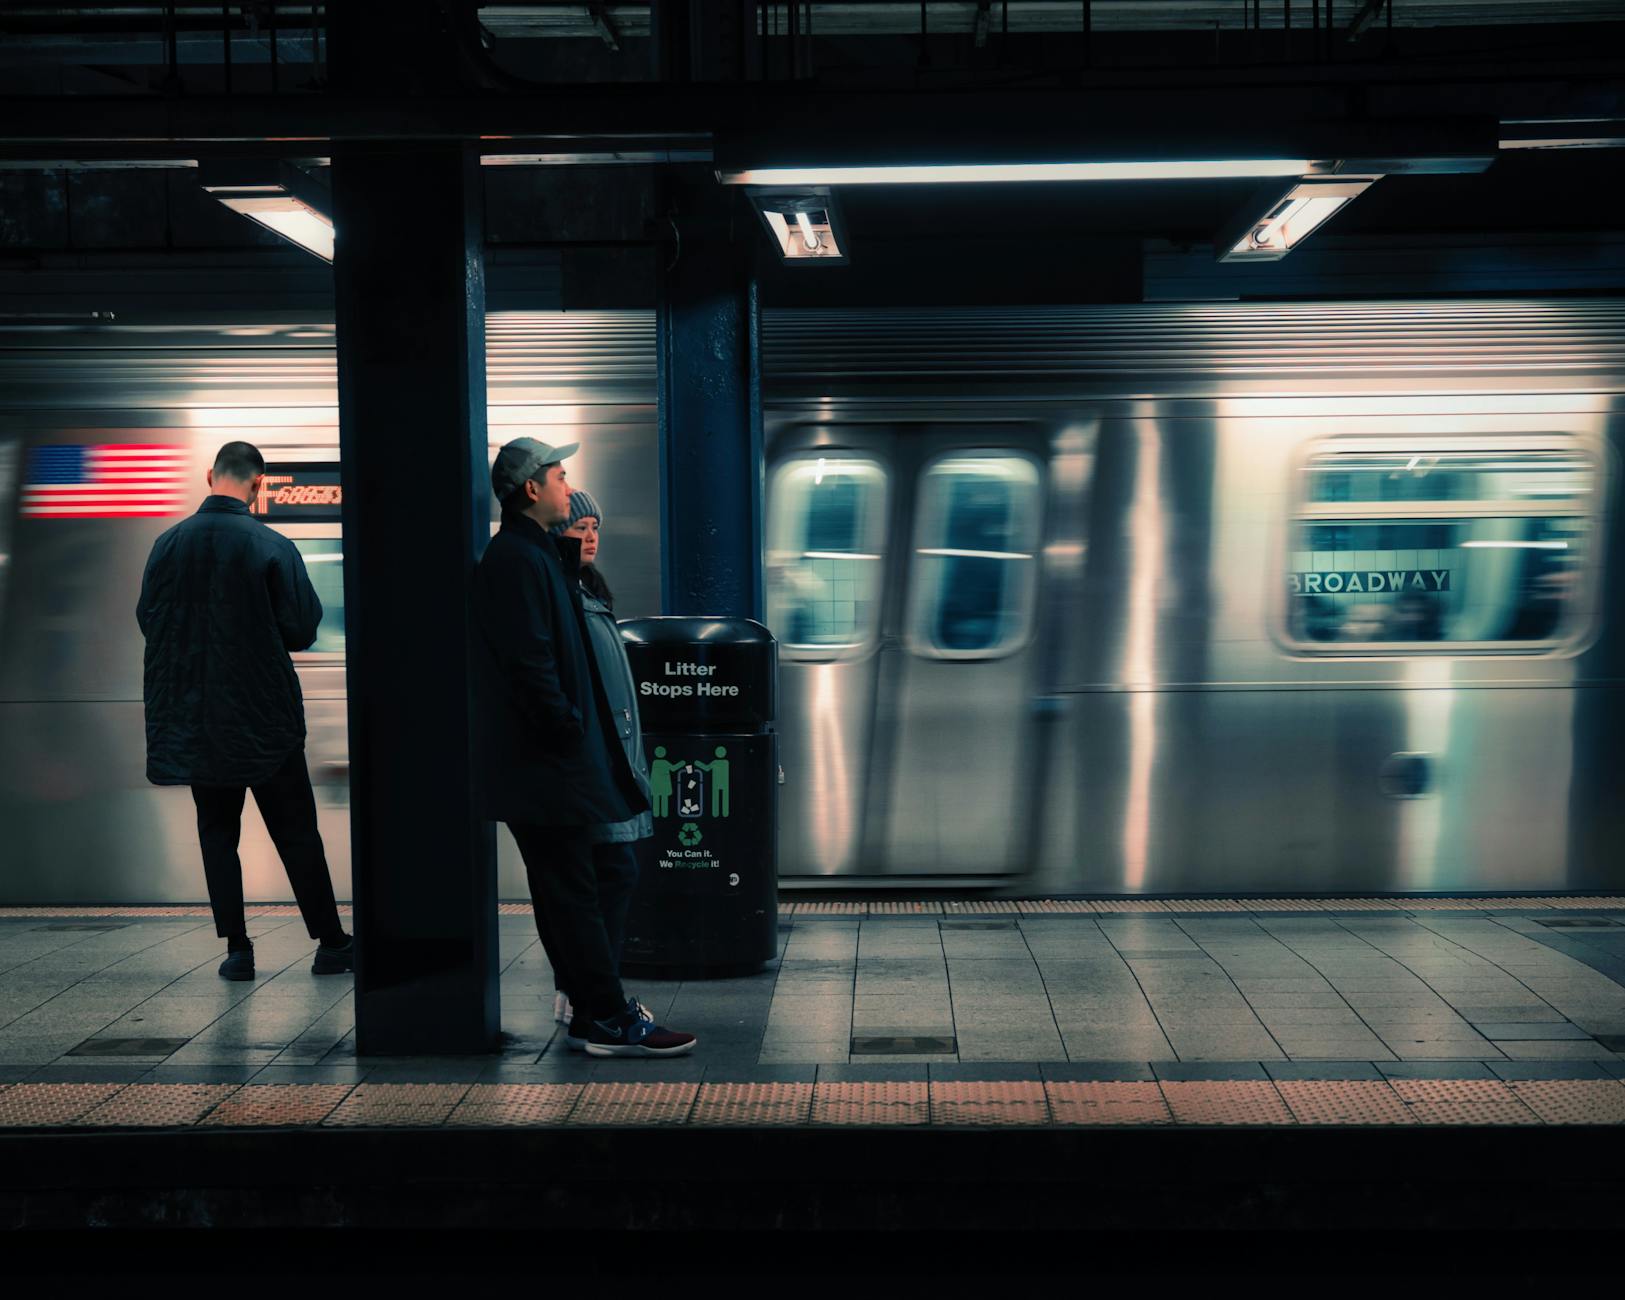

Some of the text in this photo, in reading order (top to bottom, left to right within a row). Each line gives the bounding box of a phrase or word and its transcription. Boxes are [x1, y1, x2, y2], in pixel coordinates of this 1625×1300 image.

[664, 661, 717, 676] Litter
[640, 681, 739, 699] Stops Here
[666, 849, 683, 858] You
[684, 849, 702, 858] Can
[659, 860, 674, 868] We
[674, 860, 710, 870] Recycle
